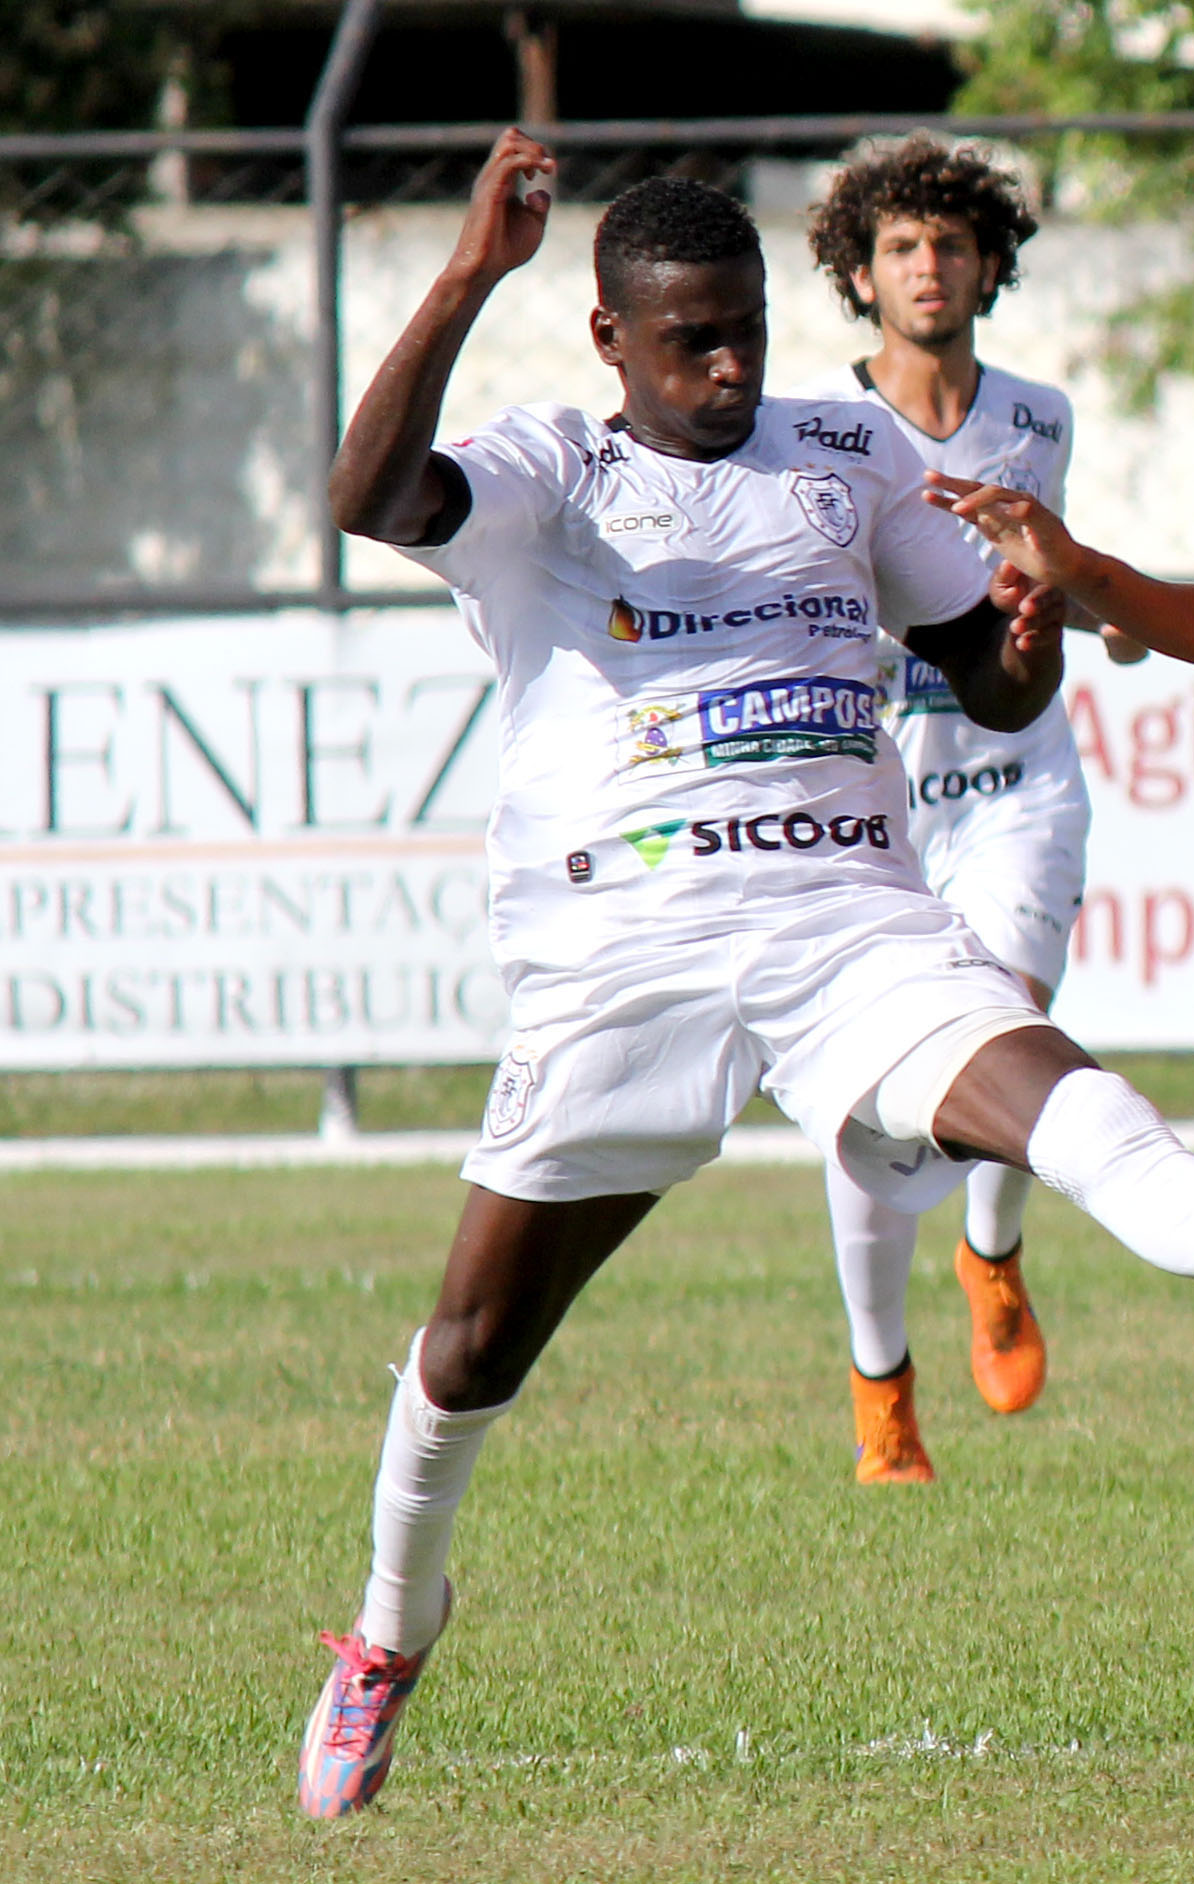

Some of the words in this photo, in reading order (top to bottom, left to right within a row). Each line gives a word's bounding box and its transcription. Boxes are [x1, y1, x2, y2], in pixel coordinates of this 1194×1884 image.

[606, 514, 673, 533] icone
[649, 594, 868, 641] Direccional
[707, 684, 876, 736] CAMPOS
[0, 672, 498, 840] ENEZ
[690, 812, 890, 857] SICOOB
[8, 868, 493, 947] PRESENTAÇ
